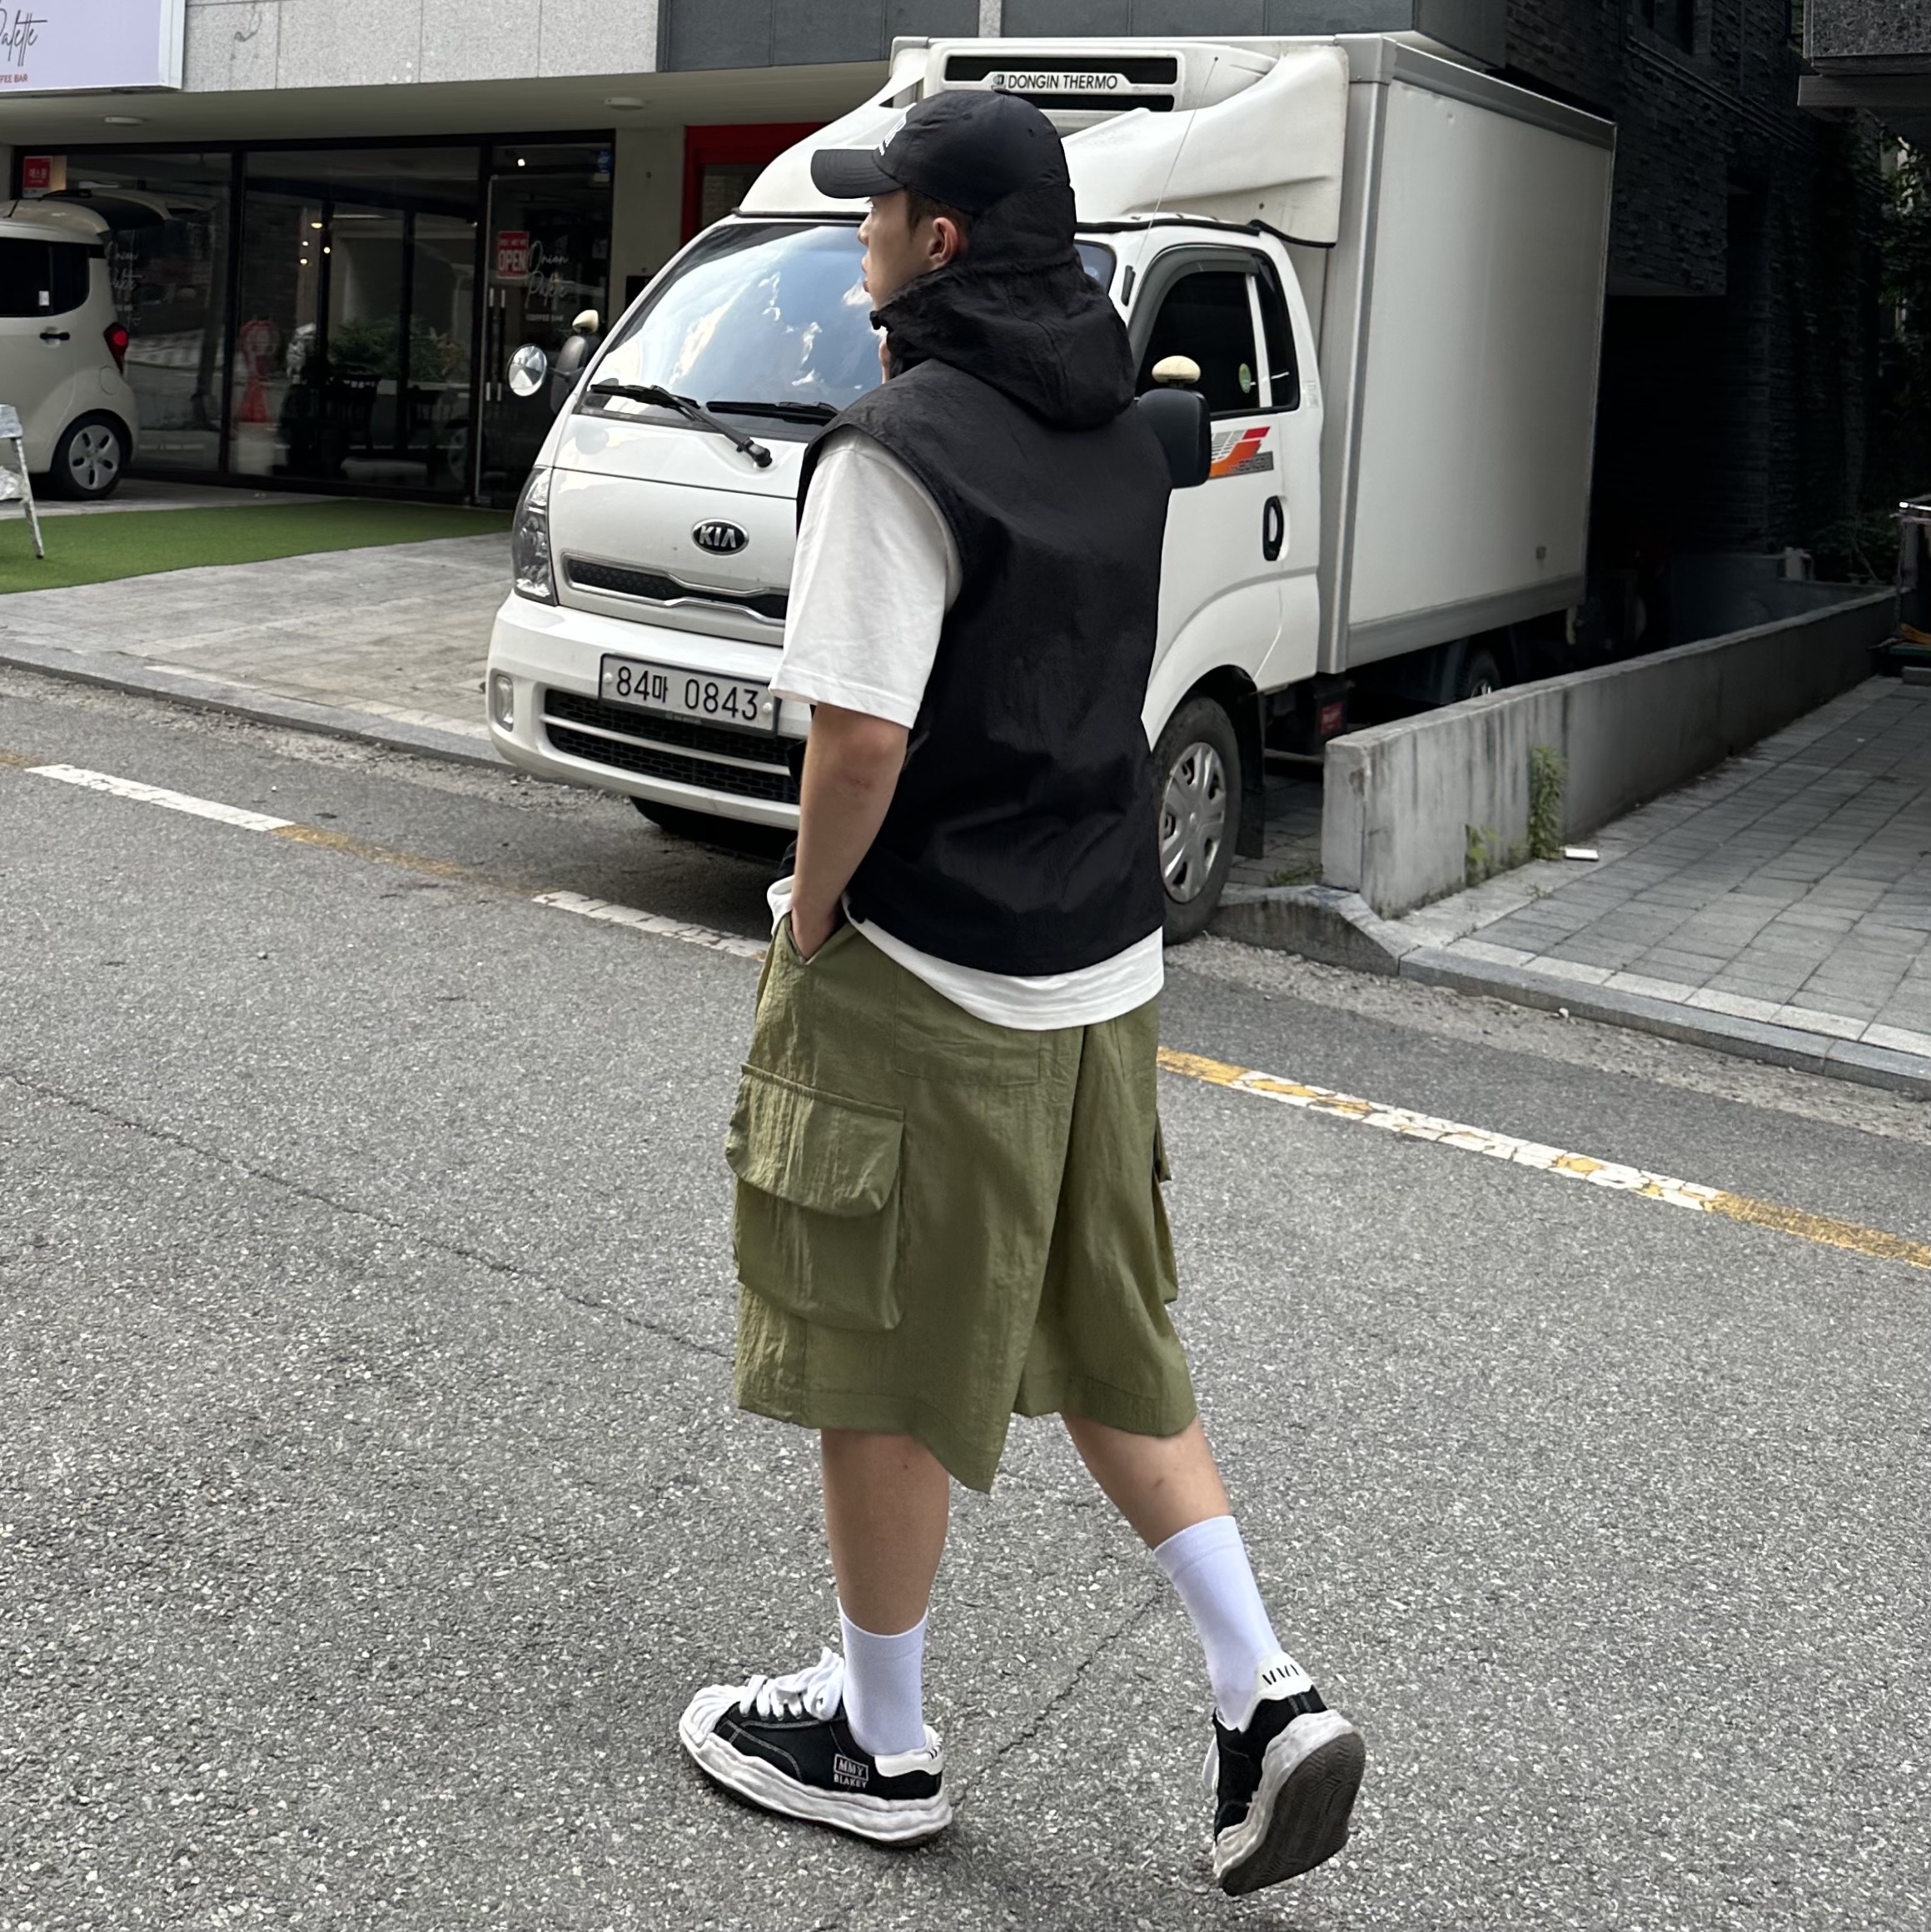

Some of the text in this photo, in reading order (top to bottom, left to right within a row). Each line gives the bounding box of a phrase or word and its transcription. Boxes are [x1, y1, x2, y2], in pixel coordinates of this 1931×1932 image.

[0, 75, 12, 83] FEE
[1008, 75, 1117, 89] DONGIN THERMO
[499, 251, 526, 271] OPEN
[699, 525, 736, 548] KIA
[617, 666, 759, 720] 84마 0843
[839, 1759, 863, 1776] MMY
[834, 1774, 867, 1788] BLAKEY
